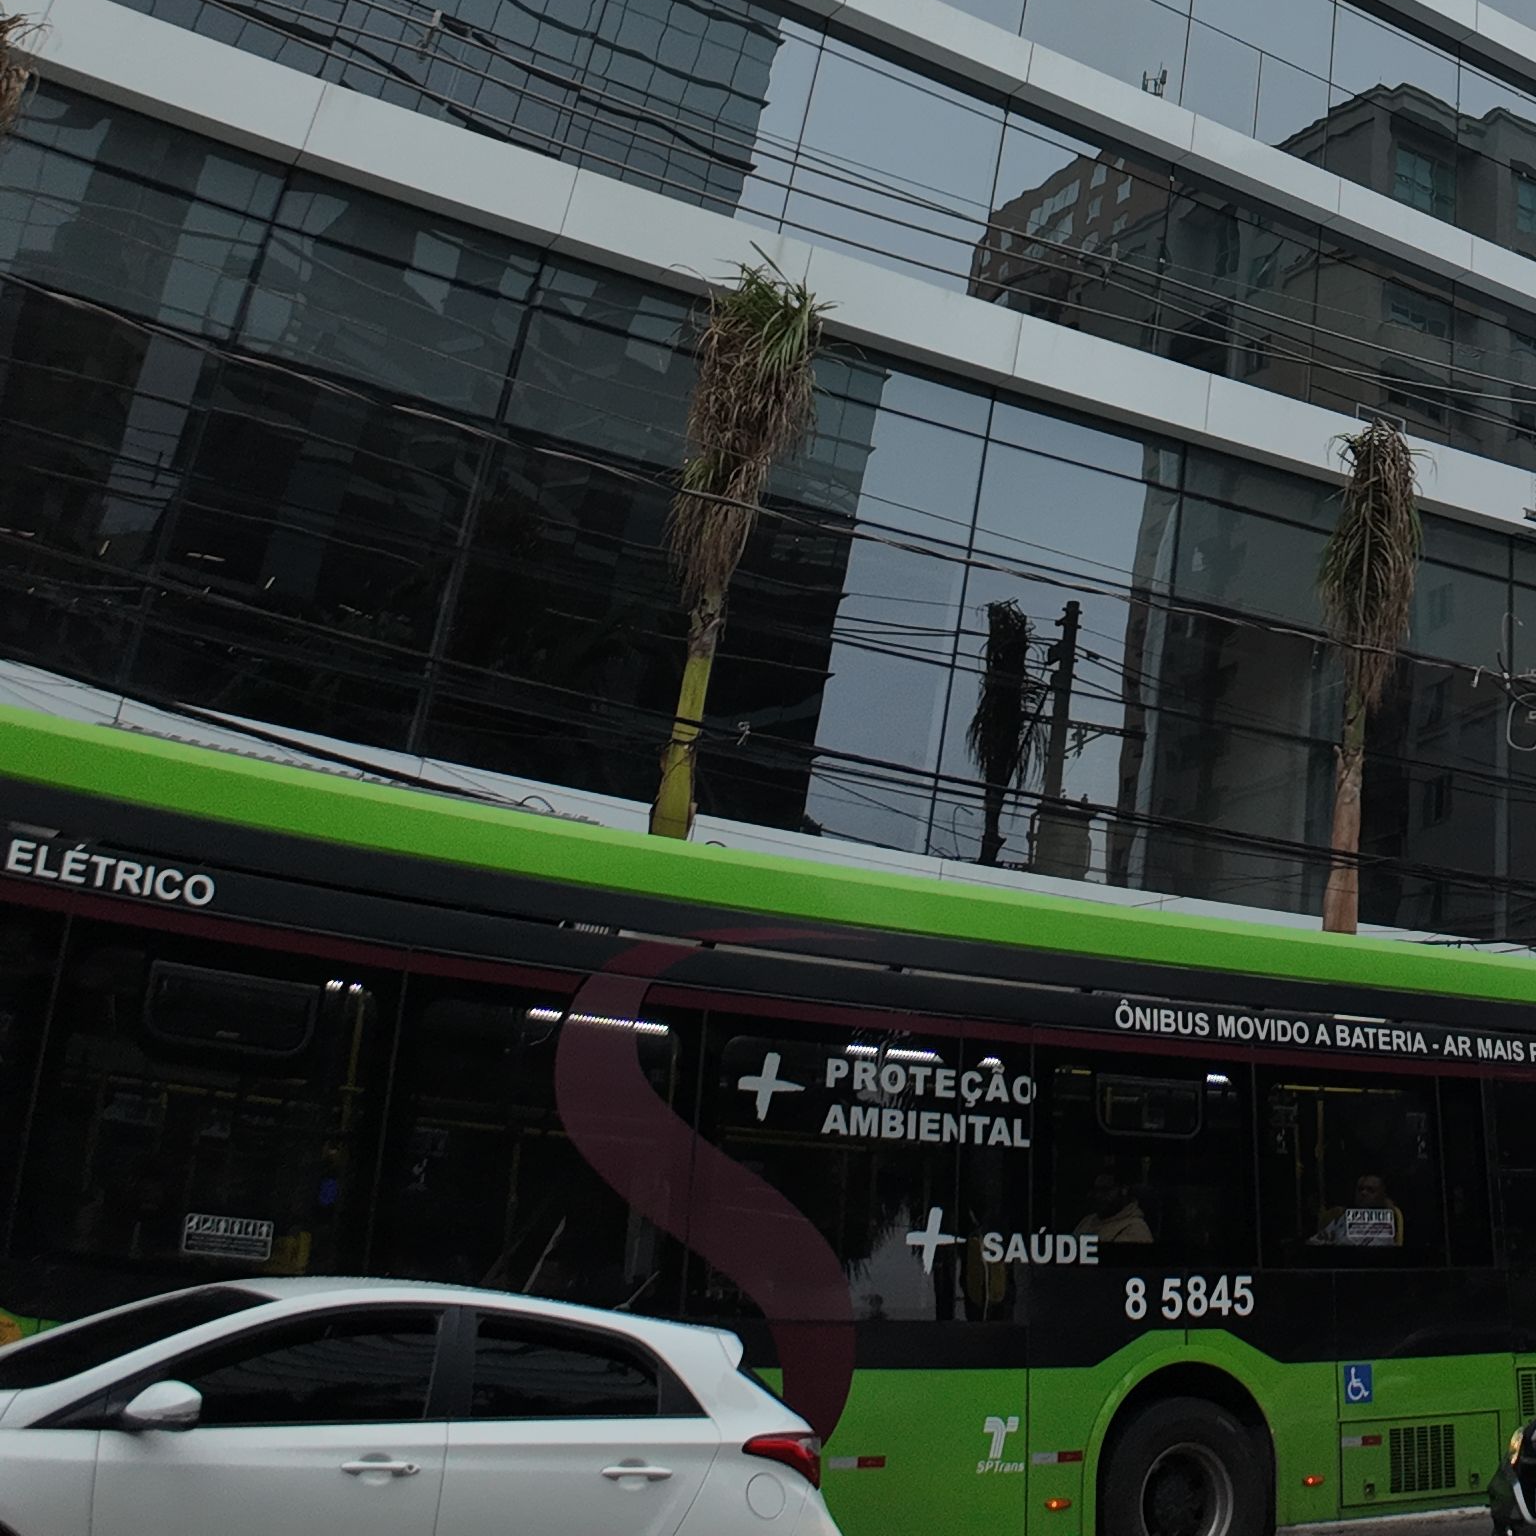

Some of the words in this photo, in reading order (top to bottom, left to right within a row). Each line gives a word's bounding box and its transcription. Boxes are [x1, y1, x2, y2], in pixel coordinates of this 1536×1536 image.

[4, 838, 215, 906] ELÉTRICO
[1115, 999, 1210, 1036] ÔNIBUS
[1217, 1014, 1310, 1045] MOVIDO
[1315, 1023, 1332, 1046] A
[1335, 1024, 1428, 1054] BATERIA
[1443, 1035, 1473, 1058] AR
[1477, 1037, 1526, 1062] MAIS
[825, 1058, 1037, 1108] PROTEÇÃO
[821, 1104, 1031, 1148] AMBIENTAL
[982, 1226, 1100, 1265] SAÚDE
[1124, 1276, 1147, 1320] 8
[1161, 1274, 1255, 1320] 5845
[975, 1460, 1025, 1474] SPTrans
